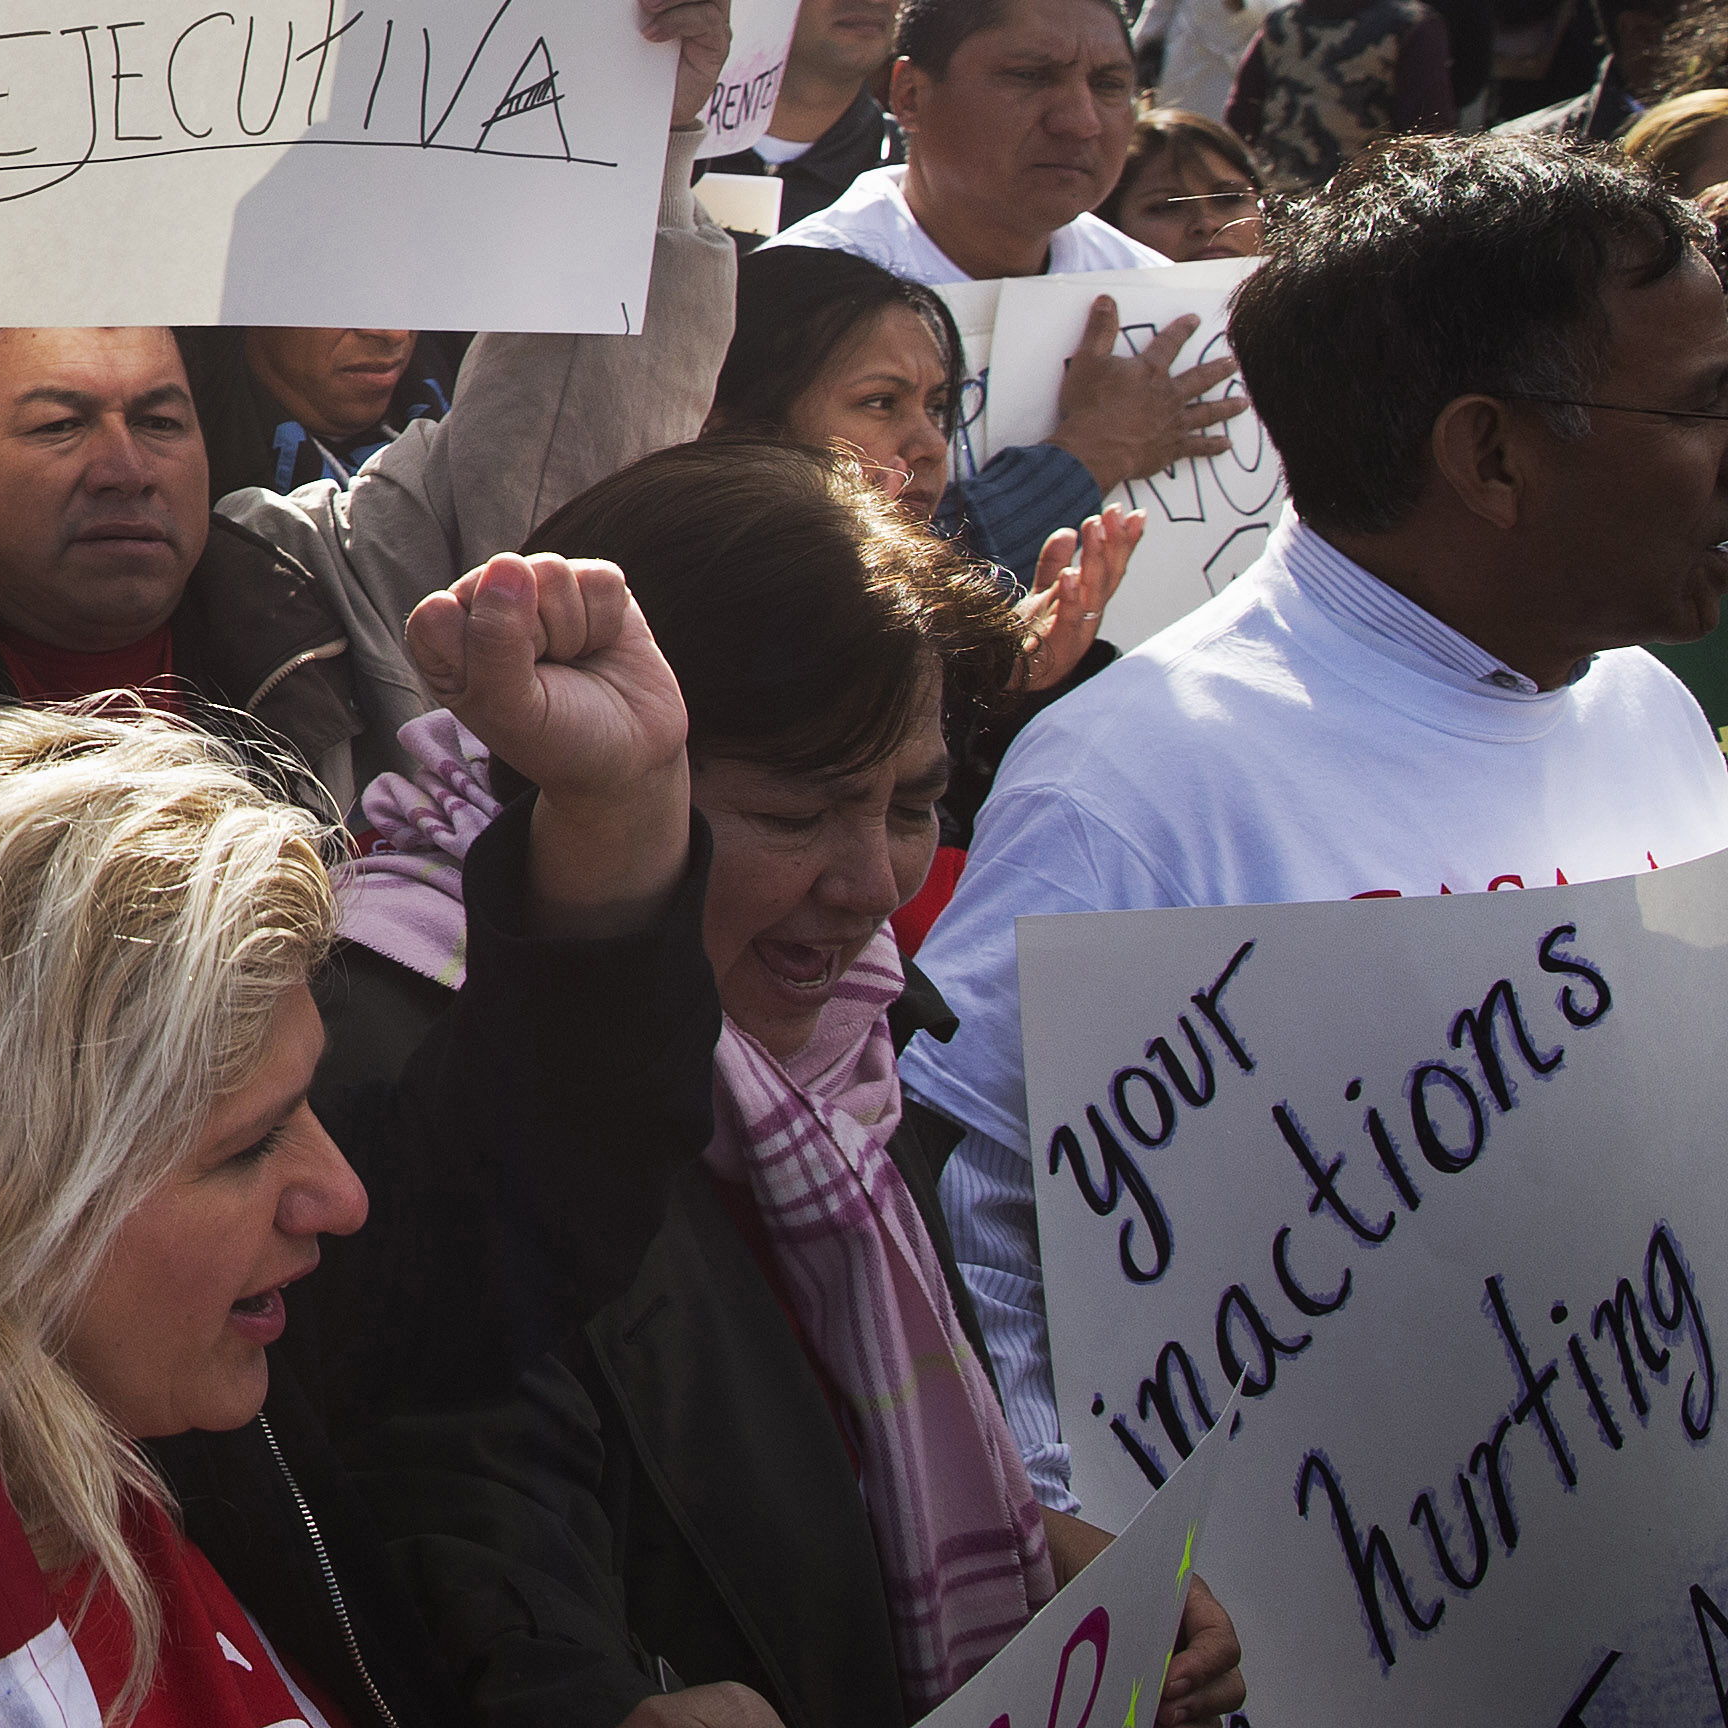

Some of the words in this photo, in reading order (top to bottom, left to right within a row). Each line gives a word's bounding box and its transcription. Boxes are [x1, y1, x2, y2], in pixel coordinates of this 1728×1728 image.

[1047, 938, 1257, 1285] your
[1089, 922, 1613, 1490] inactions
[1293, 1218, 1718, 1674] hurting
